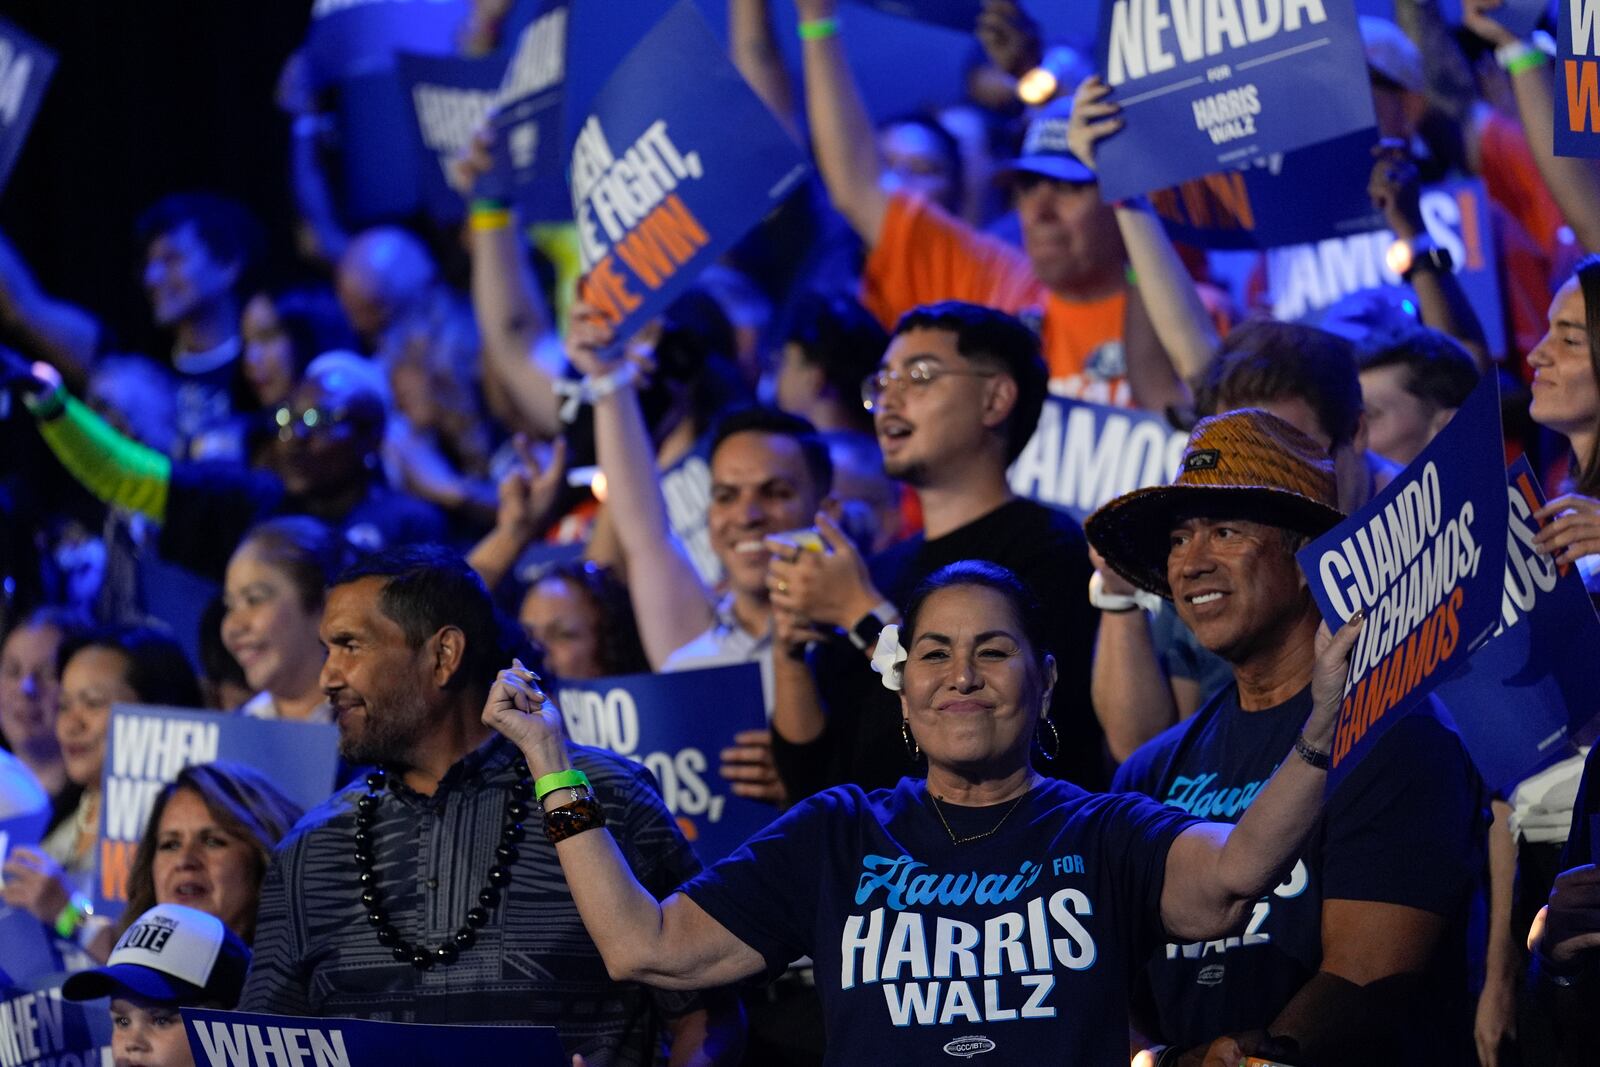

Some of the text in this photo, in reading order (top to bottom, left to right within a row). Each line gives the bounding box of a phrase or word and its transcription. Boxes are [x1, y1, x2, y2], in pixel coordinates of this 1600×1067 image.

[1207, 64, 1232, 83] FOR
[1192, 84, 1261, 131] HARRIS
[1208, 115, 1257, 145] WALZ
[591, 119, 704, 243] FIGHT,
[614, 194, 710, 290] WIN
[1319, 461, 1441, 623] CUANDO
[1333, 586, 1463, 768] GANAMOS
[113, 714, 219, 783] WHEN
[1053, 854, 1085, 876] FOR
[841, 888, 1097, 990] HARRIS
[883, 974, 1057, 1026] WALZ
[192, 1020, 351, 1067] WHEN
